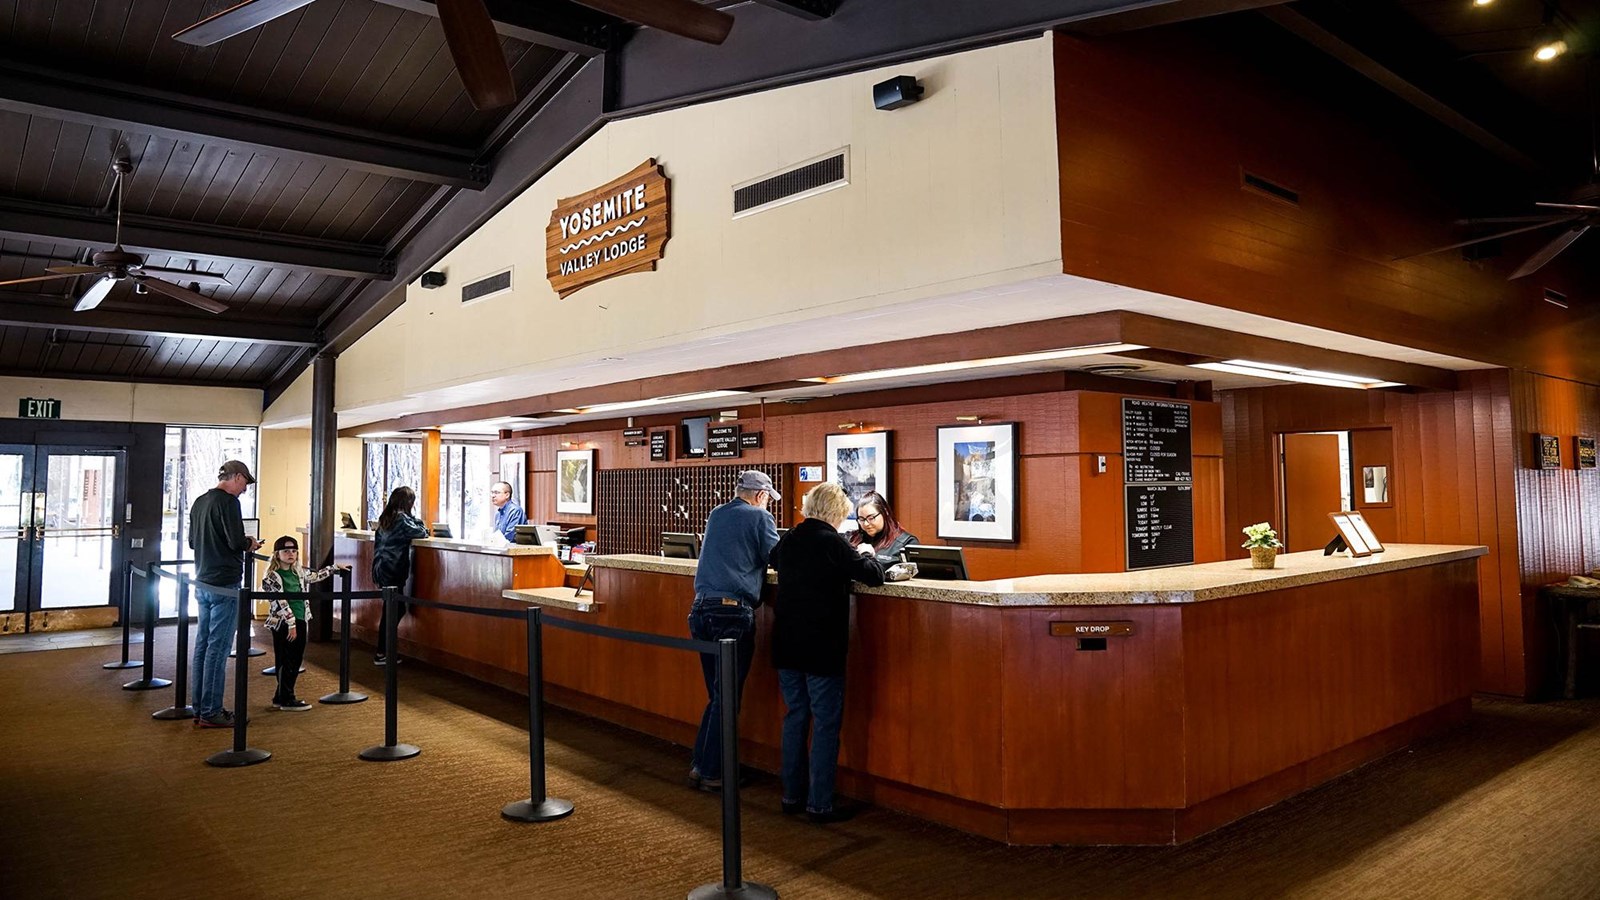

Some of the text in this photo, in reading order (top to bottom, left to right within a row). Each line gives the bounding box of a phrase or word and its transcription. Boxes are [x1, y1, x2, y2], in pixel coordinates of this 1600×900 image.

[560, 184, 645, 239] YOSEMITE
[560, 234, 645, 276] VALLEY LODGE
[28, 400, 55, 418] EXIT
